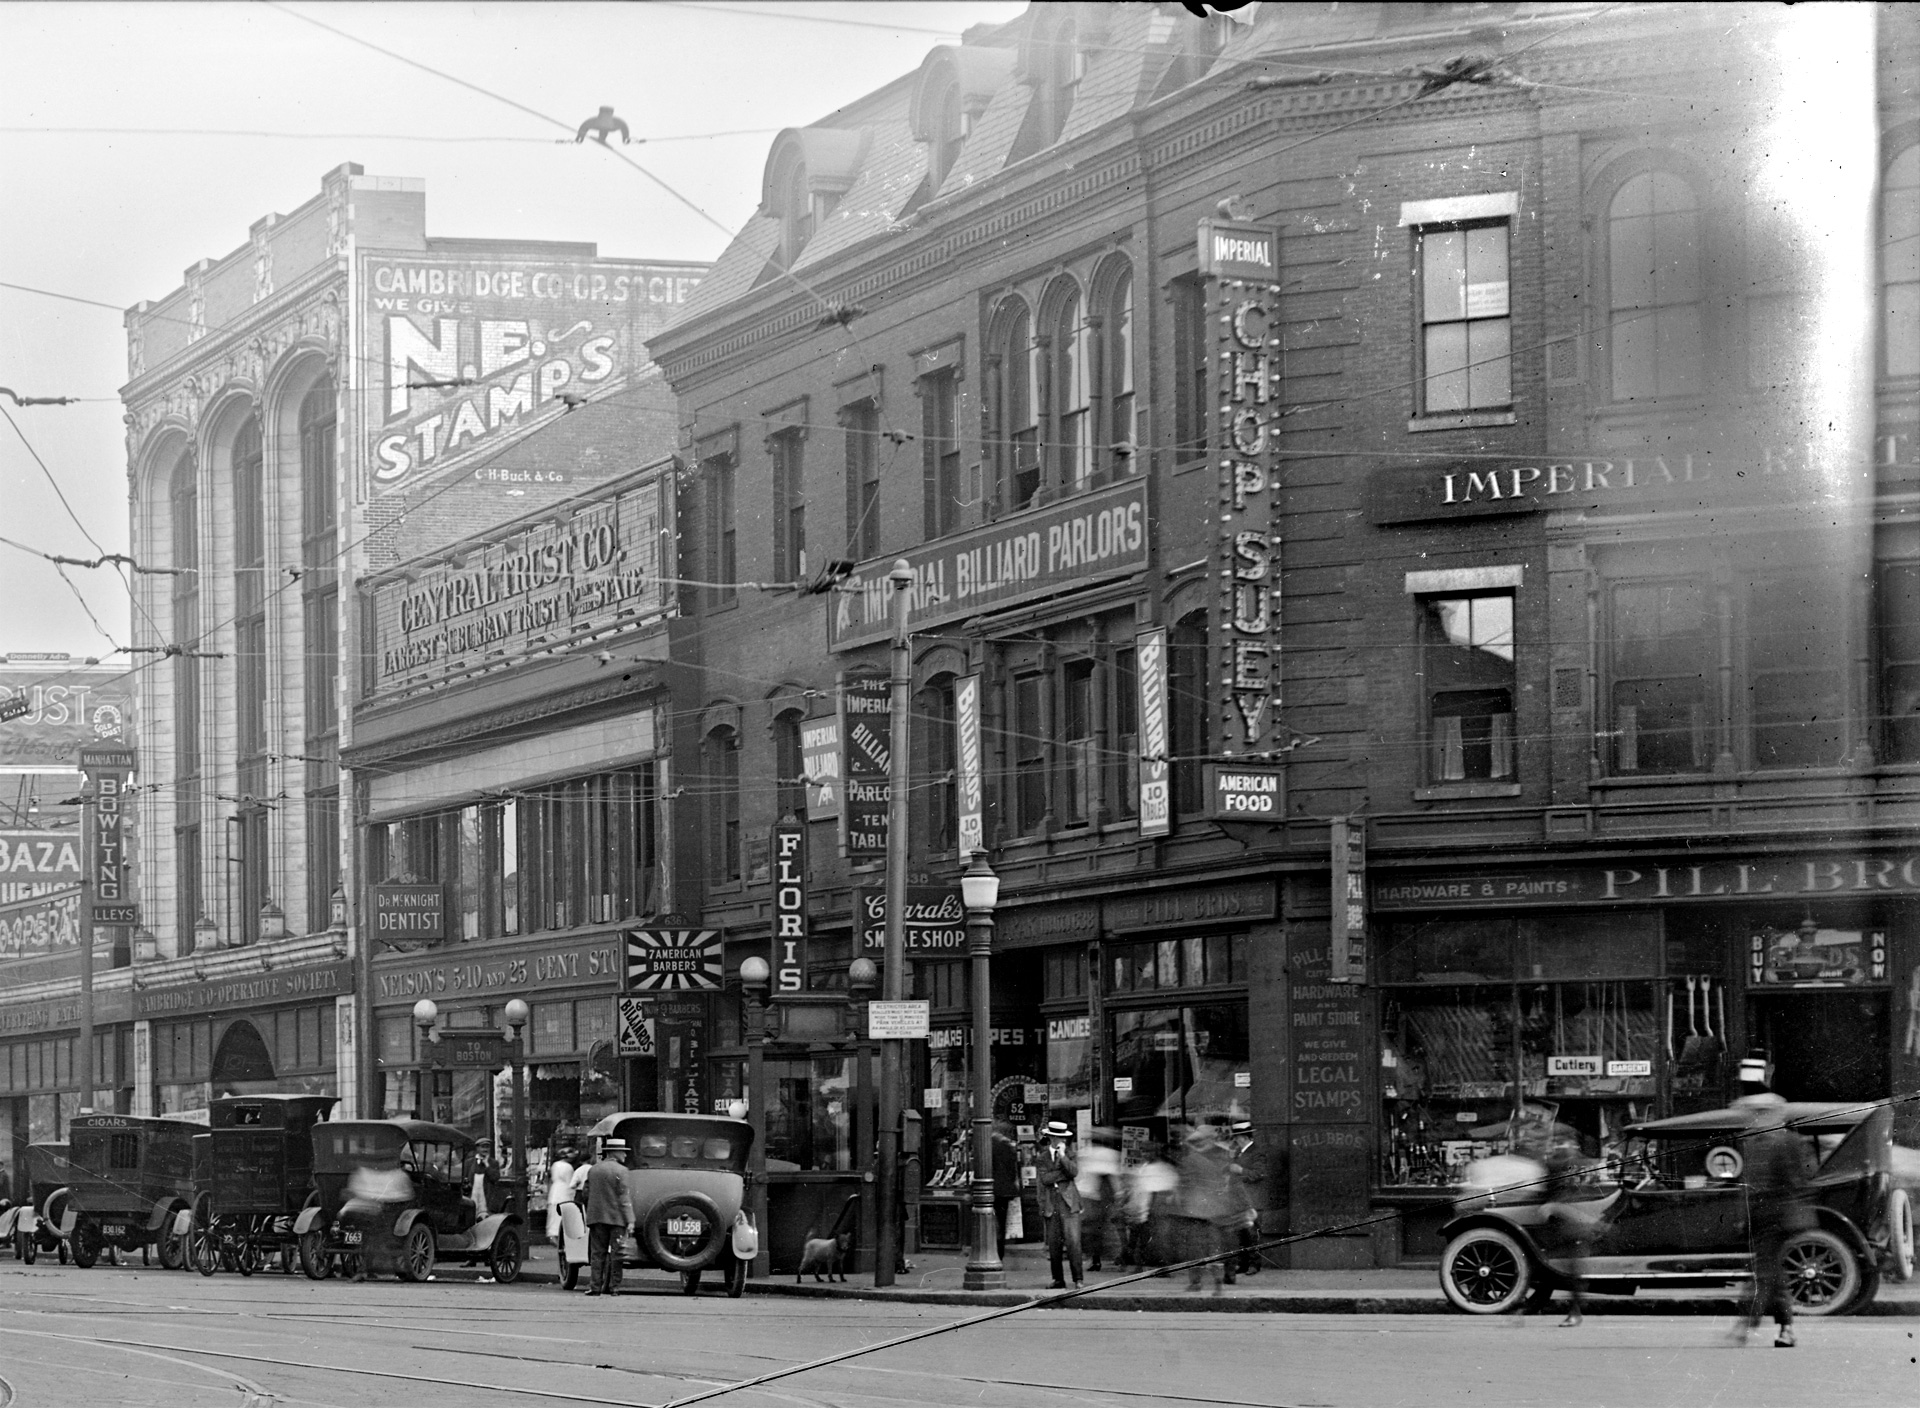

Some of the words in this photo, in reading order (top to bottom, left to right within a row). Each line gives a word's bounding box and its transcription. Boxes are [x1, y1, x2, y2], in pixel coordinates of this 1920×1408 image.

[1214, 236, 1271, 267] IMPERIAL
[374, 266, 525, 298] CAMBRIDGE
[374, 298, 409, 312] WE
[416, 299, 473, 313] GIVE
[376, 335, 616, 481] STAMPS
[1232, 299, 1270, 510] CHOP
[1442, 454, 1711, 505] IMPERIAL
[863, 558, 950, 625] IMPRIAL
[956, 531, 1041, 600] BILLIARD
[1048, 501, 1142, 573] PARLORS
[400, 567, 500, 636] CENTRAL
[500, 537, 576, 598] TRUST
[383, 637, 439, 678] LARGEST
[439, 609, 514, 659] SUBURBAN
[514, 596, 561, 634] TRUST
[593, 565, 644, 608] STATE
[1232, 530, 1271, 743] SUEY
[861, 679, 886, 691] THE
[1139, 634, 1167, 780] BILLIARDS
[102, 726, 121, 738] DUST
[803, 724, 838, 750] IMPERIAL
[958, 680, 981, 812] BILLIARDS
[83, 754, 132, 767] MANHATTAN
[1219, 774, 1277, 792] AMERICAN
[1147, 785, 1162, 800] 10
[1225, 794, 1272, 812] FOOD
[964, 818, 978, 832] 10
[98, 779, 119, 899] BOWLING
[906, 873, 928, 884] 38
[1600, 863, 1773, 900] PILL
[1377, 882, 1472, 901] HARDWARE
[1480, 881, 1494, 897] &
[1506, 879, 1568, 895] PAINTS
[92, 908, 135, 921] LLEYS
[865, 893, 964, 921] Carak's
[379, 912, 440, 930] DENTIST
[864, 930, 918, 948] SME
[921, 930, 965, 948] SHOP
[648, 949, 655, 960] 7
[655, 949, 702, 960] AMERICAN
[1752, 936, 1763, 983] BUY
[1872, 932, 1885, 978] NOW
[653, 960, 697, 972] BARBERS
[379, 967, 446, 998] NELSON'S
[485, 971, 506, 987] AND
[509, 960, 528, 983] 25
[535, 953, 580, 982] CENT
[137, 988, 195, 1014] CAMBRIDGE
[285, 969, 340, 993] SOCIETY
[1293, 984, 1359, 1000] HARDWARE
[0, 1009, 49, 1030] VERYTHING
[620, 998, 654, 1053] BILLIARDS
[1293, 1012, 1323, 1027] PAINT
[1327, 1011, 1361, 1026] STORE
[928, 1029, 962, 1048] CIGARS
[971, 1028, 1025, 1046] PES
[1049, 1018, 1091, 1040] CANDIES
[467, 1043, 481, 1052] TO
[1321, 1040, 1347, 1049] GIVE
[456, 1051, 492, 1062] BOSTON
[1554, 1059, 1596, 1072] Cutlery
[1298, 1065, 1360, 1083] LEGAL
[1010, 1102, 1024, 1114] 52
[1294, 1090, 1361, 1108] STAMPS
[87, 1117, 127, 1128] CIGARS
[345, 1232, 362, 1242] 7663
